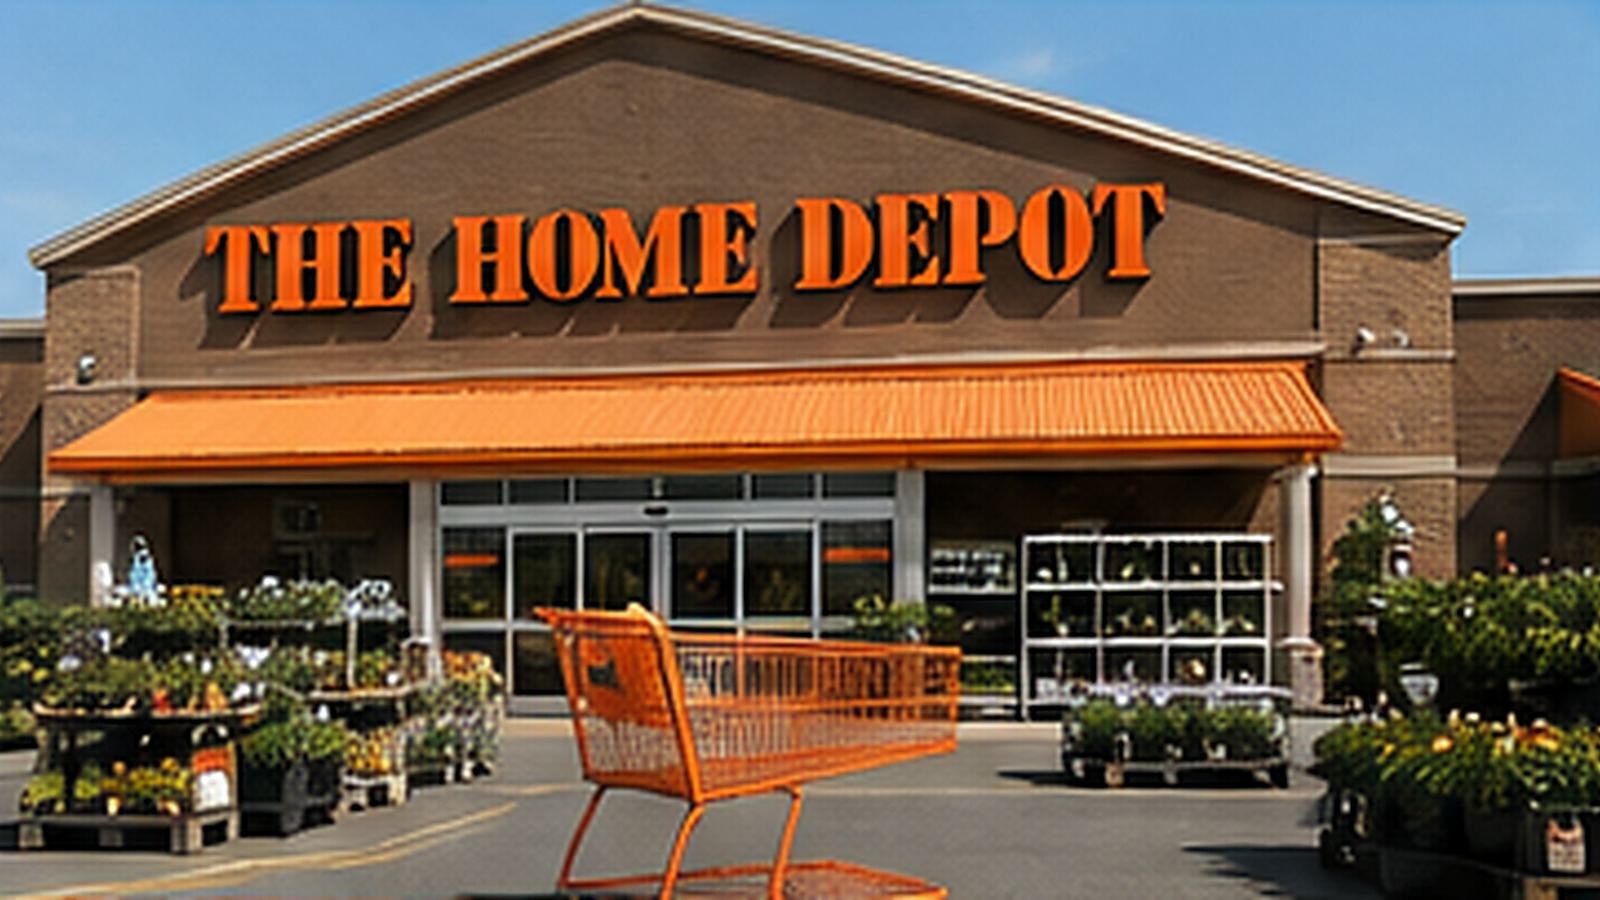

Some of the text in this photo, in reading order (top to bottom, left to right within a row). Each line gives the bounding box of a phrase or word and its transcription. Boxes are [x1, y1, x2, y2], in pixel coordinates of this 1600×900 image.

[206, 183, 1166, 311] THE HOME DEPOT
